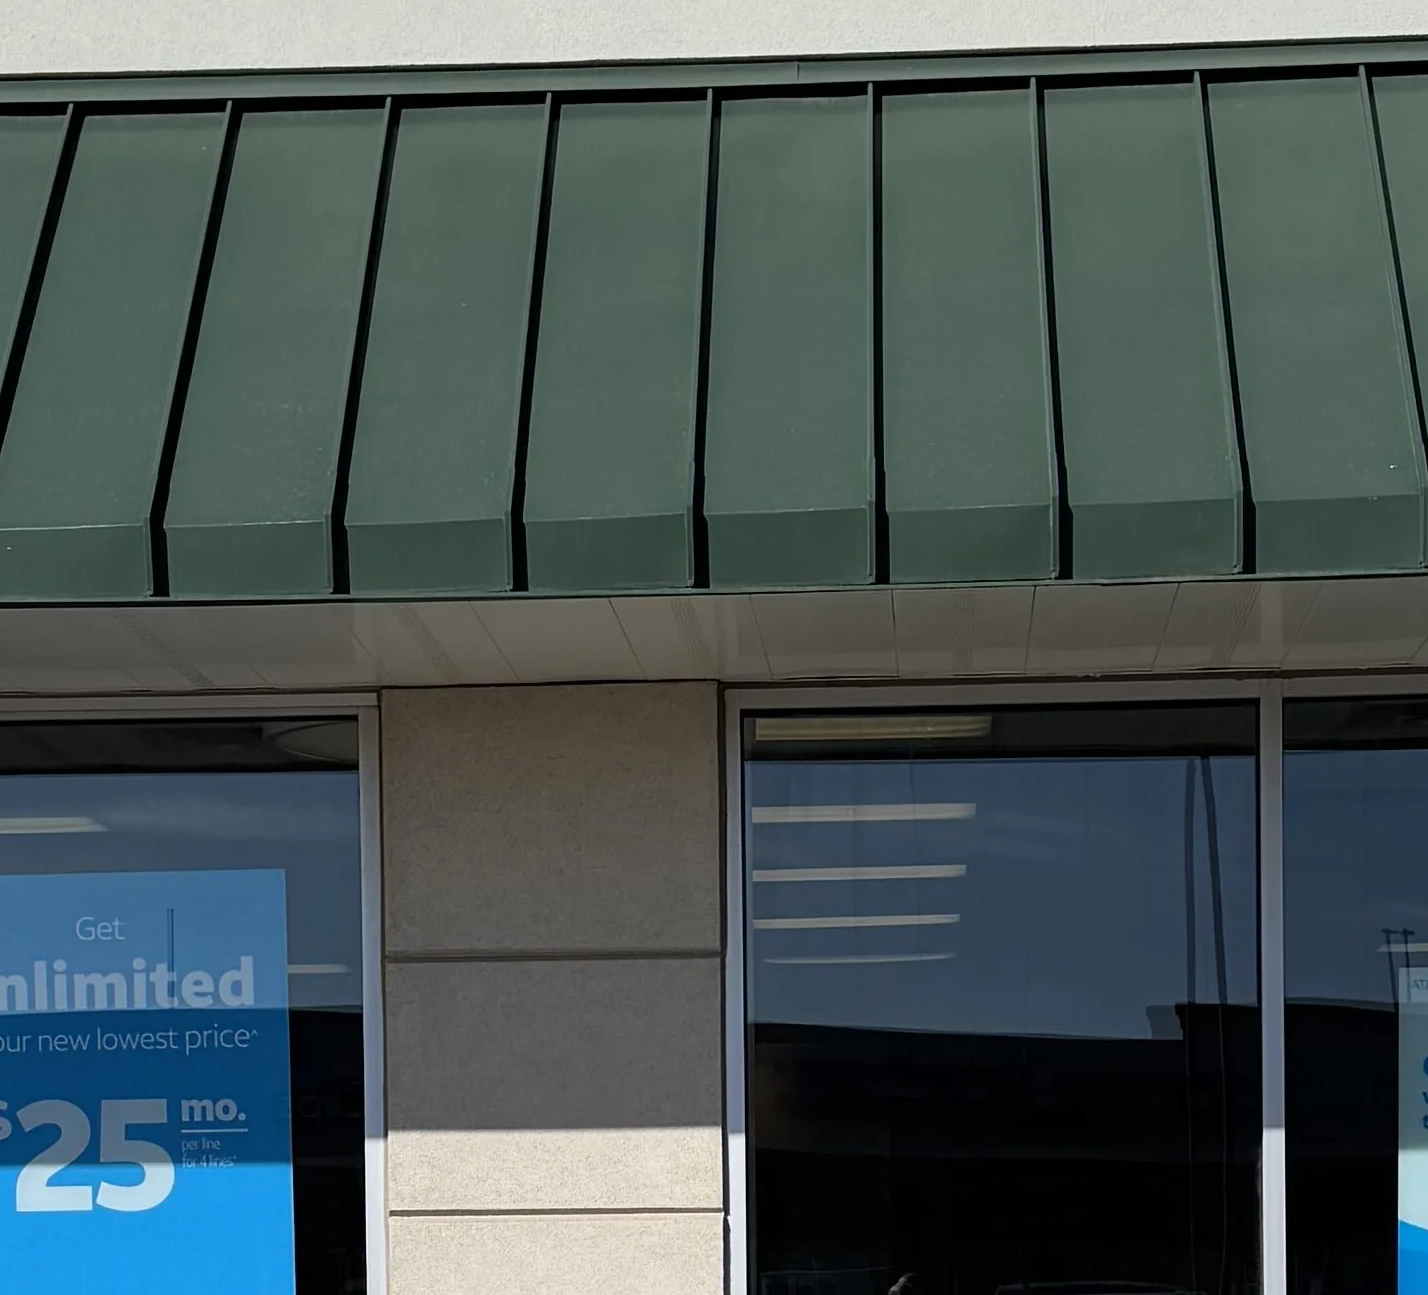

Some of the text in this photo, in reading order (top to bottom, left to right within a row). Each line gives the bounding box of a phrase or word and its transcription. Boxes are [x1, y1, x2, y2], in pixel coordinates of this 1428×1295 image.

[75, 916, 125, 941] Get
[38, 1031, 91, 1051] new
[96, 1027, 178, 1050] lowest
[181, 1098, 247, 1123] mo.
